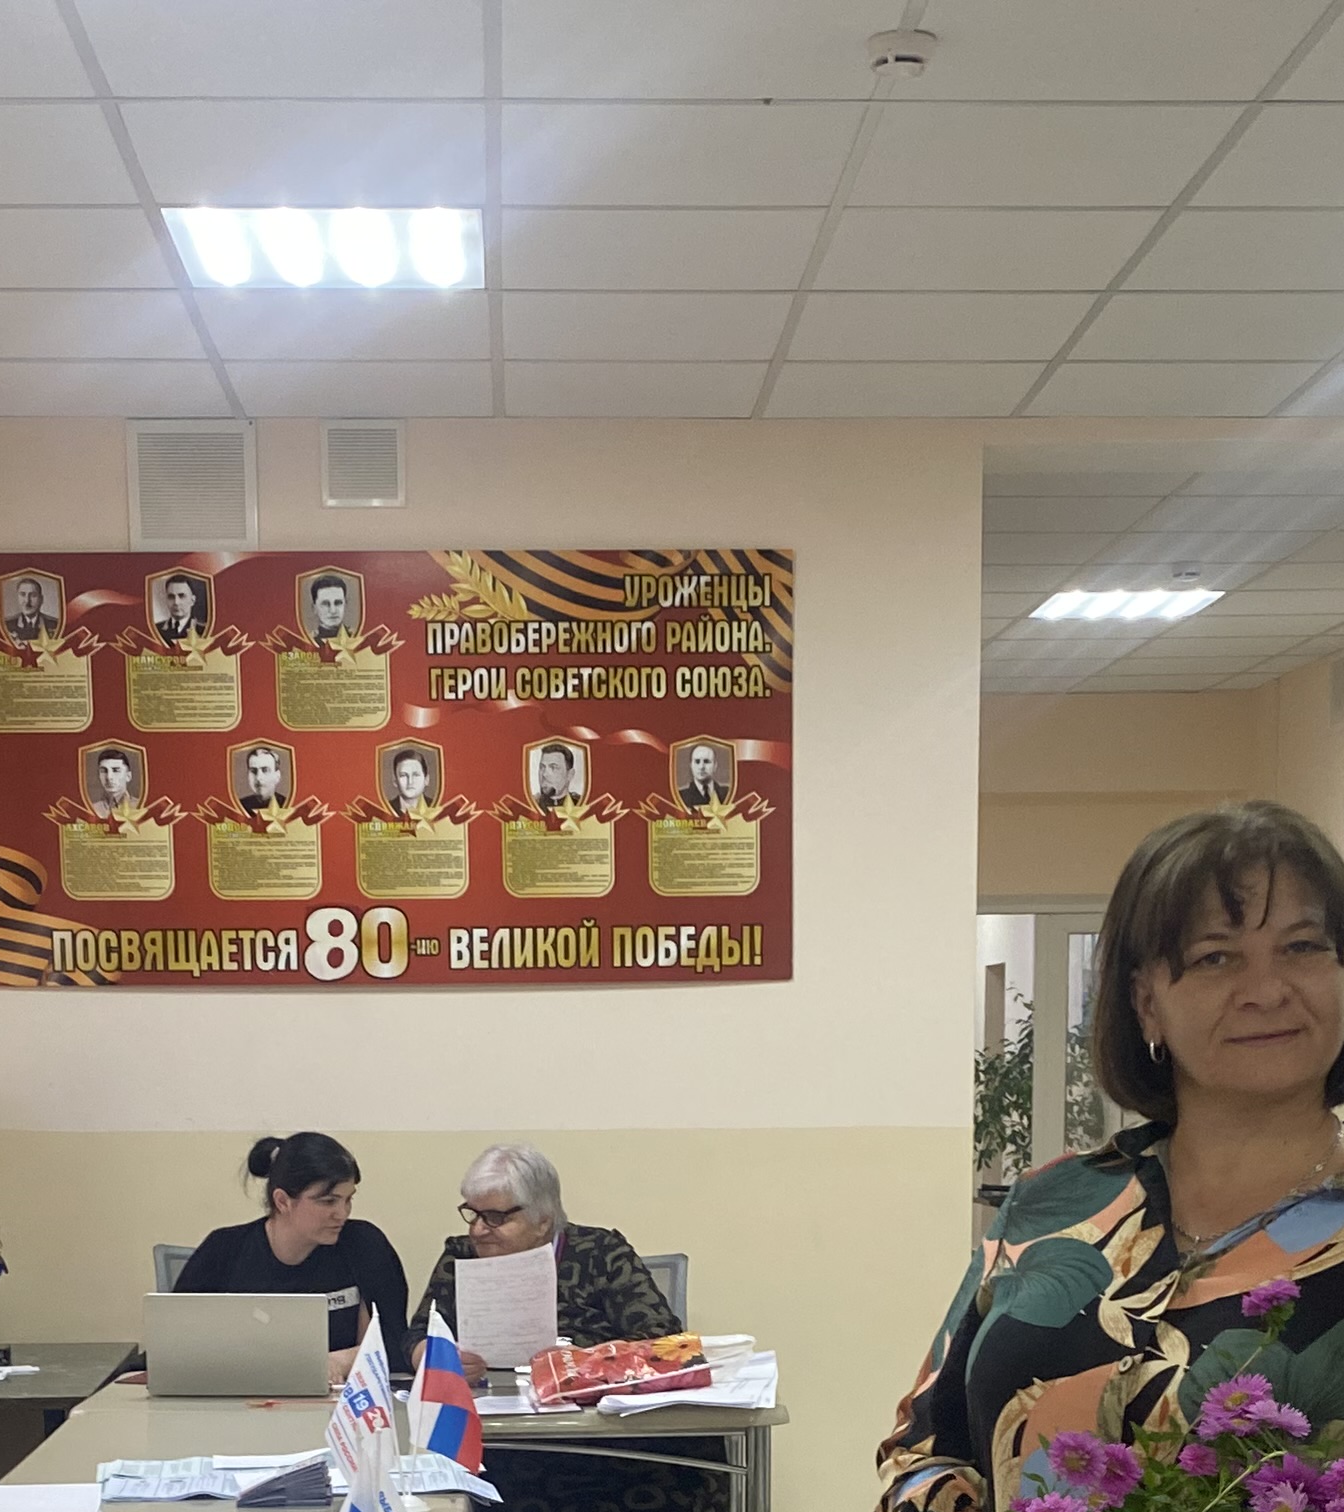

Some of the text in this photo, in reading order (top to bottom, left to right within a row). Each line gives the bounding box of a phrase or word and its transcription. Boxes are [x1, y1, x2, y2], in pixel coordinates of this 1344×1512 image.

[624, 574, 771, 611] УРОЖЕНЦЫ
[426, 616, 772, 655] ПРАВОБЕРЕЖНОГО РАЙОНА.
[429, 665, 772, 700] ГЕРОИ СОВЕТСКОГО СОЮЗА.
[52, 929, 298, 978] ПОСВЯЩАЕТСЯ
[448, 918, 600, 970] ВЕЛИКОЙ
[612, 923, 763, 974] ПОБЕДЫ!
[354, 1390, 369, 1413] 19
